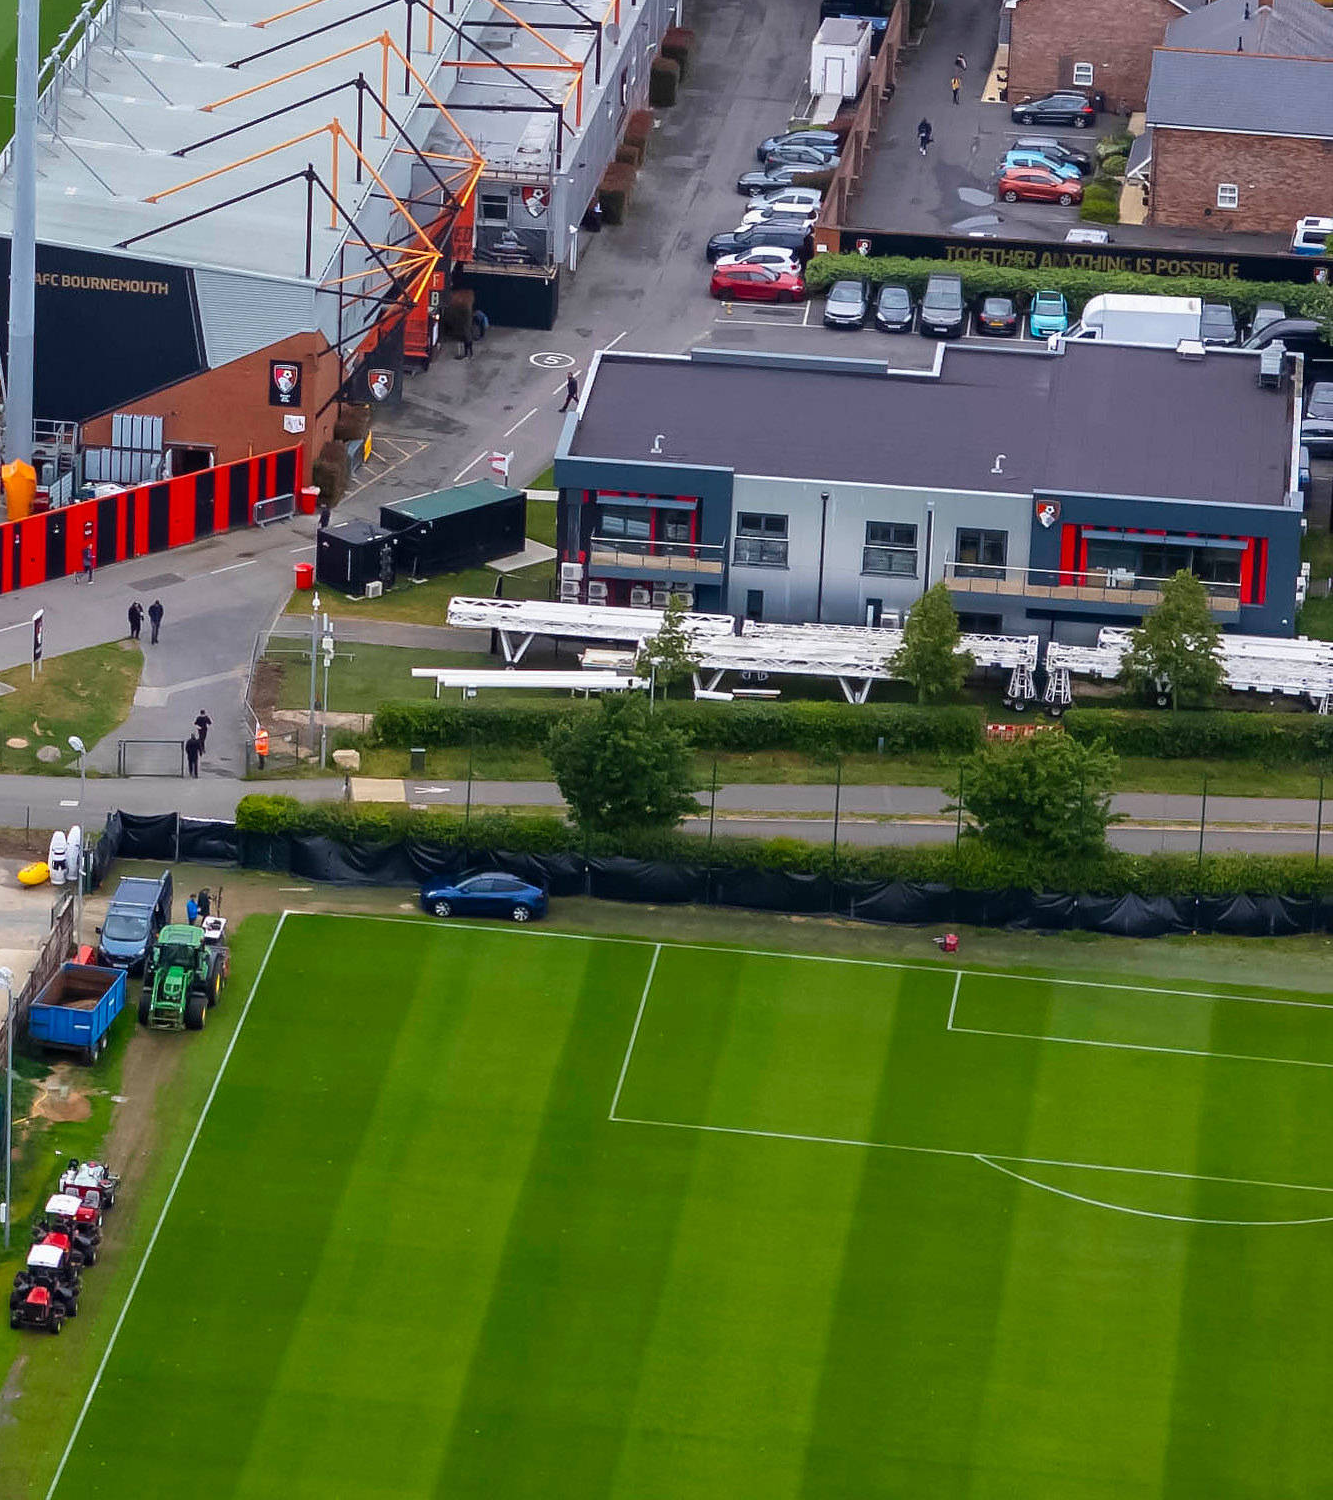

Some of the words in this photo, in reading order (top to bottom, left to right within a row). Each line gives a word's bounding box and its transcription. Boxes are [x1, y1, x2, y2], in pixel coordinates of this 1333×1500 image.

[945, 245, 1036, 268] TOGETHER
[1136, 257, 1152, 274] IS
[1155, 258, 1239, 279] POSSIBLE
[34, 272, 59, 287] AFC
[61, 274, 169, 296] BOURNEMOUTH
